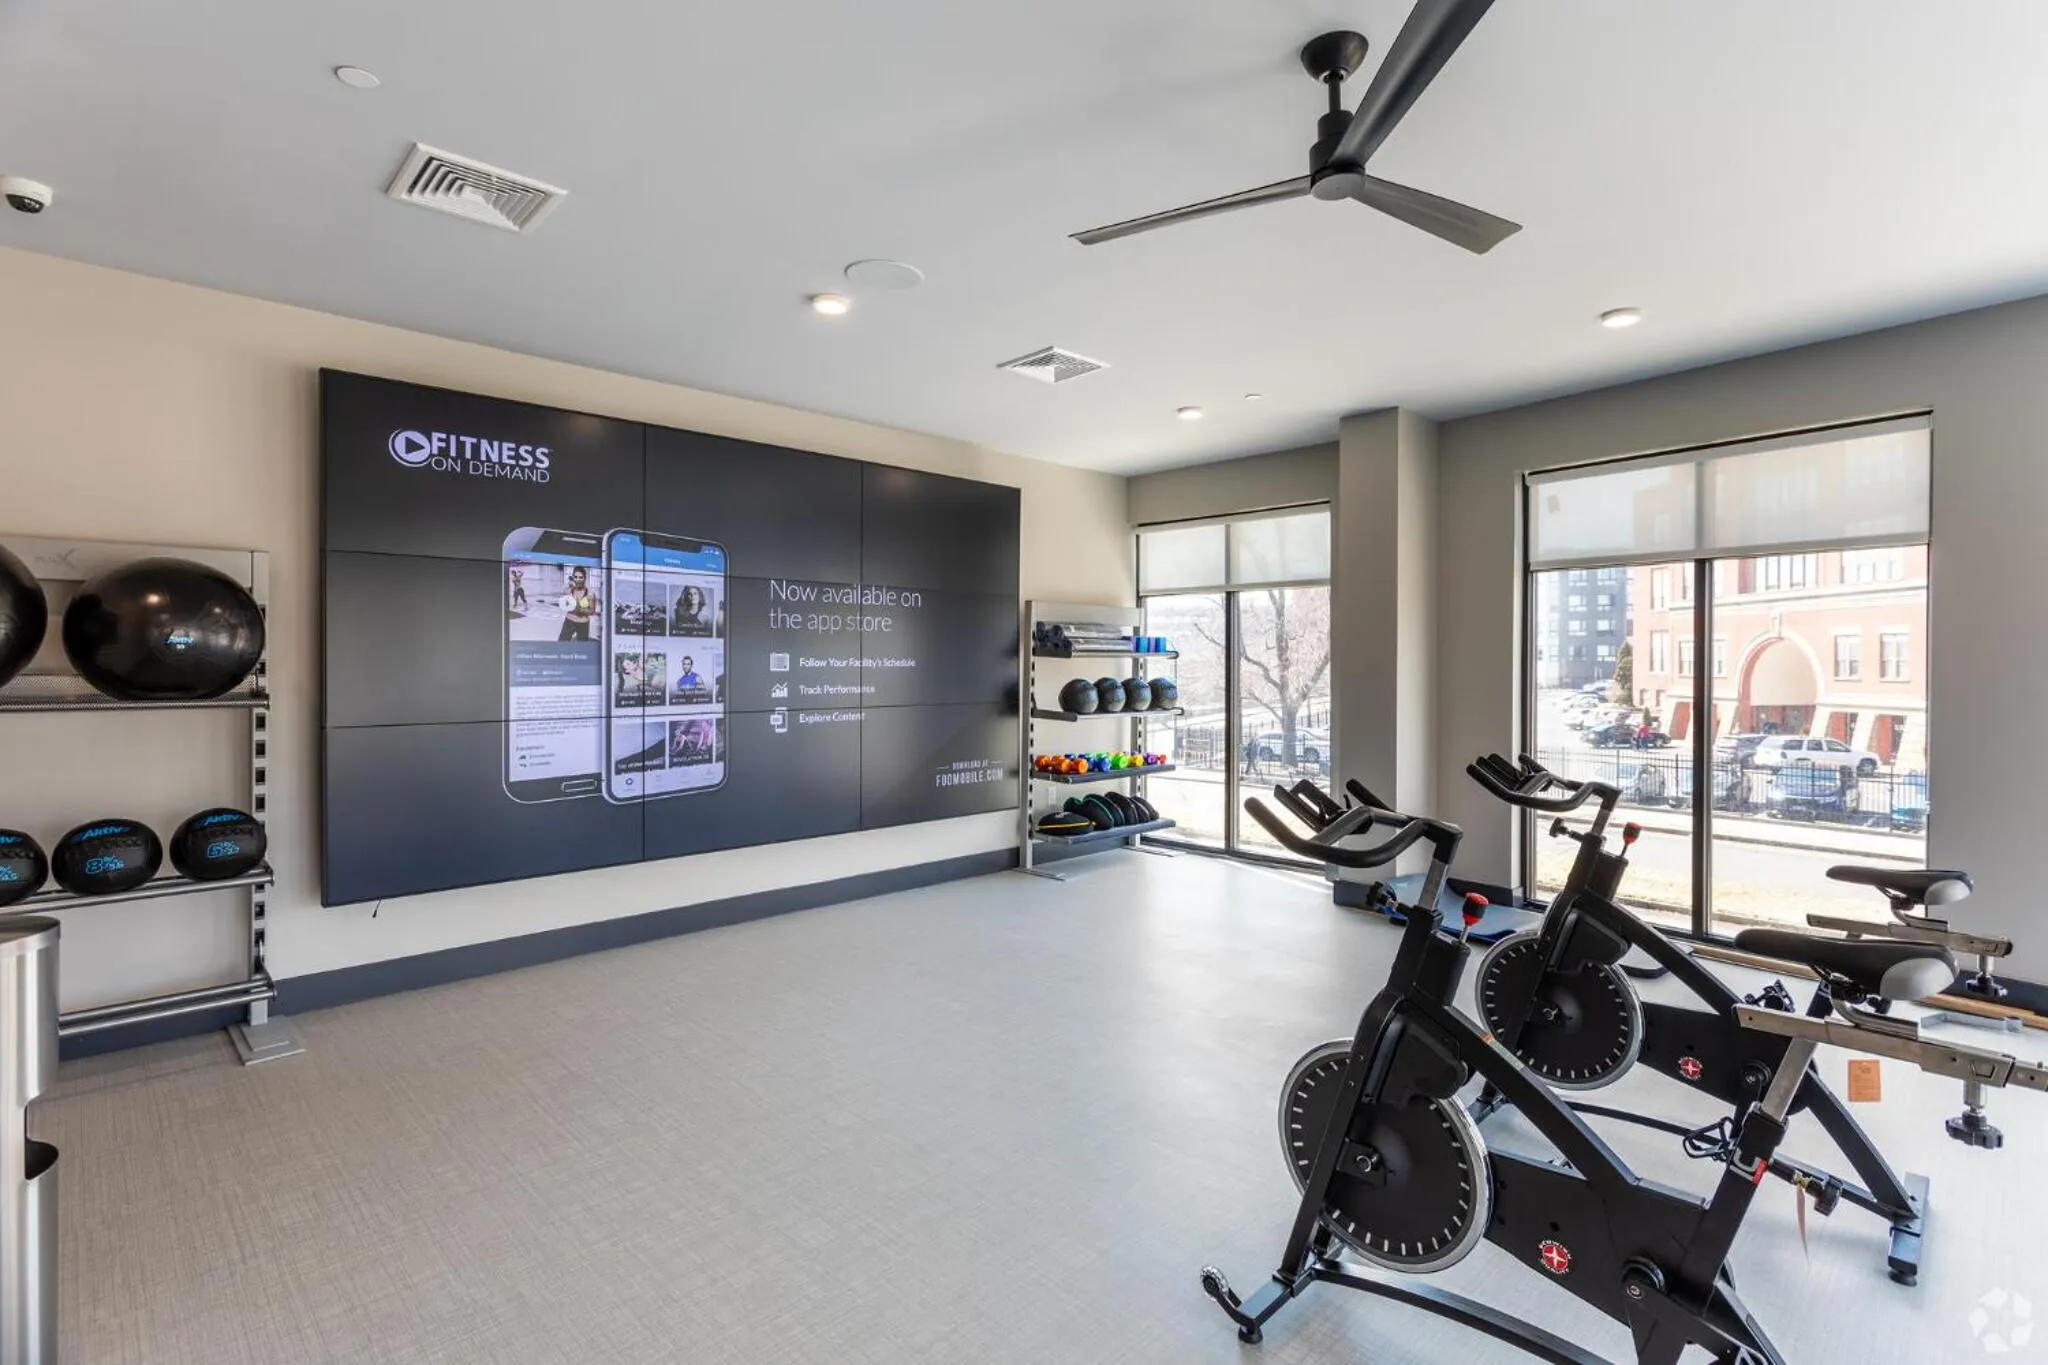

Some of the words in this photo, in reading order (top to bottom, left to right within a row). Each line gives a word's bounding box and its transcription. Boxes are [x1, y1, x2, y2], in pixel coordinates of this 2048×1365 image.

[431, 431, 550, 469] FITNESS
[431, 456, 461, 473] ON
[469, 460, 550, 483] DEMAND
[770, 579, 818, 602] Now
[822, 584, 897, 606] available
[900, 591, 922, 608] on
[769, 608, 802, 630] the
[807, 613, 842, 635] app
[846, 612, 893, 632] store
[799, 657, 827, 667] Follow
[828, 658, 848, 668] Your
[883, 658, 916, 668] Schedule
[799, 685, 822, 695] Track
[823, 684, 876, 695] Performance
[799, 713, 832, 724] Explore
[832, 711, 866, 722] Content
